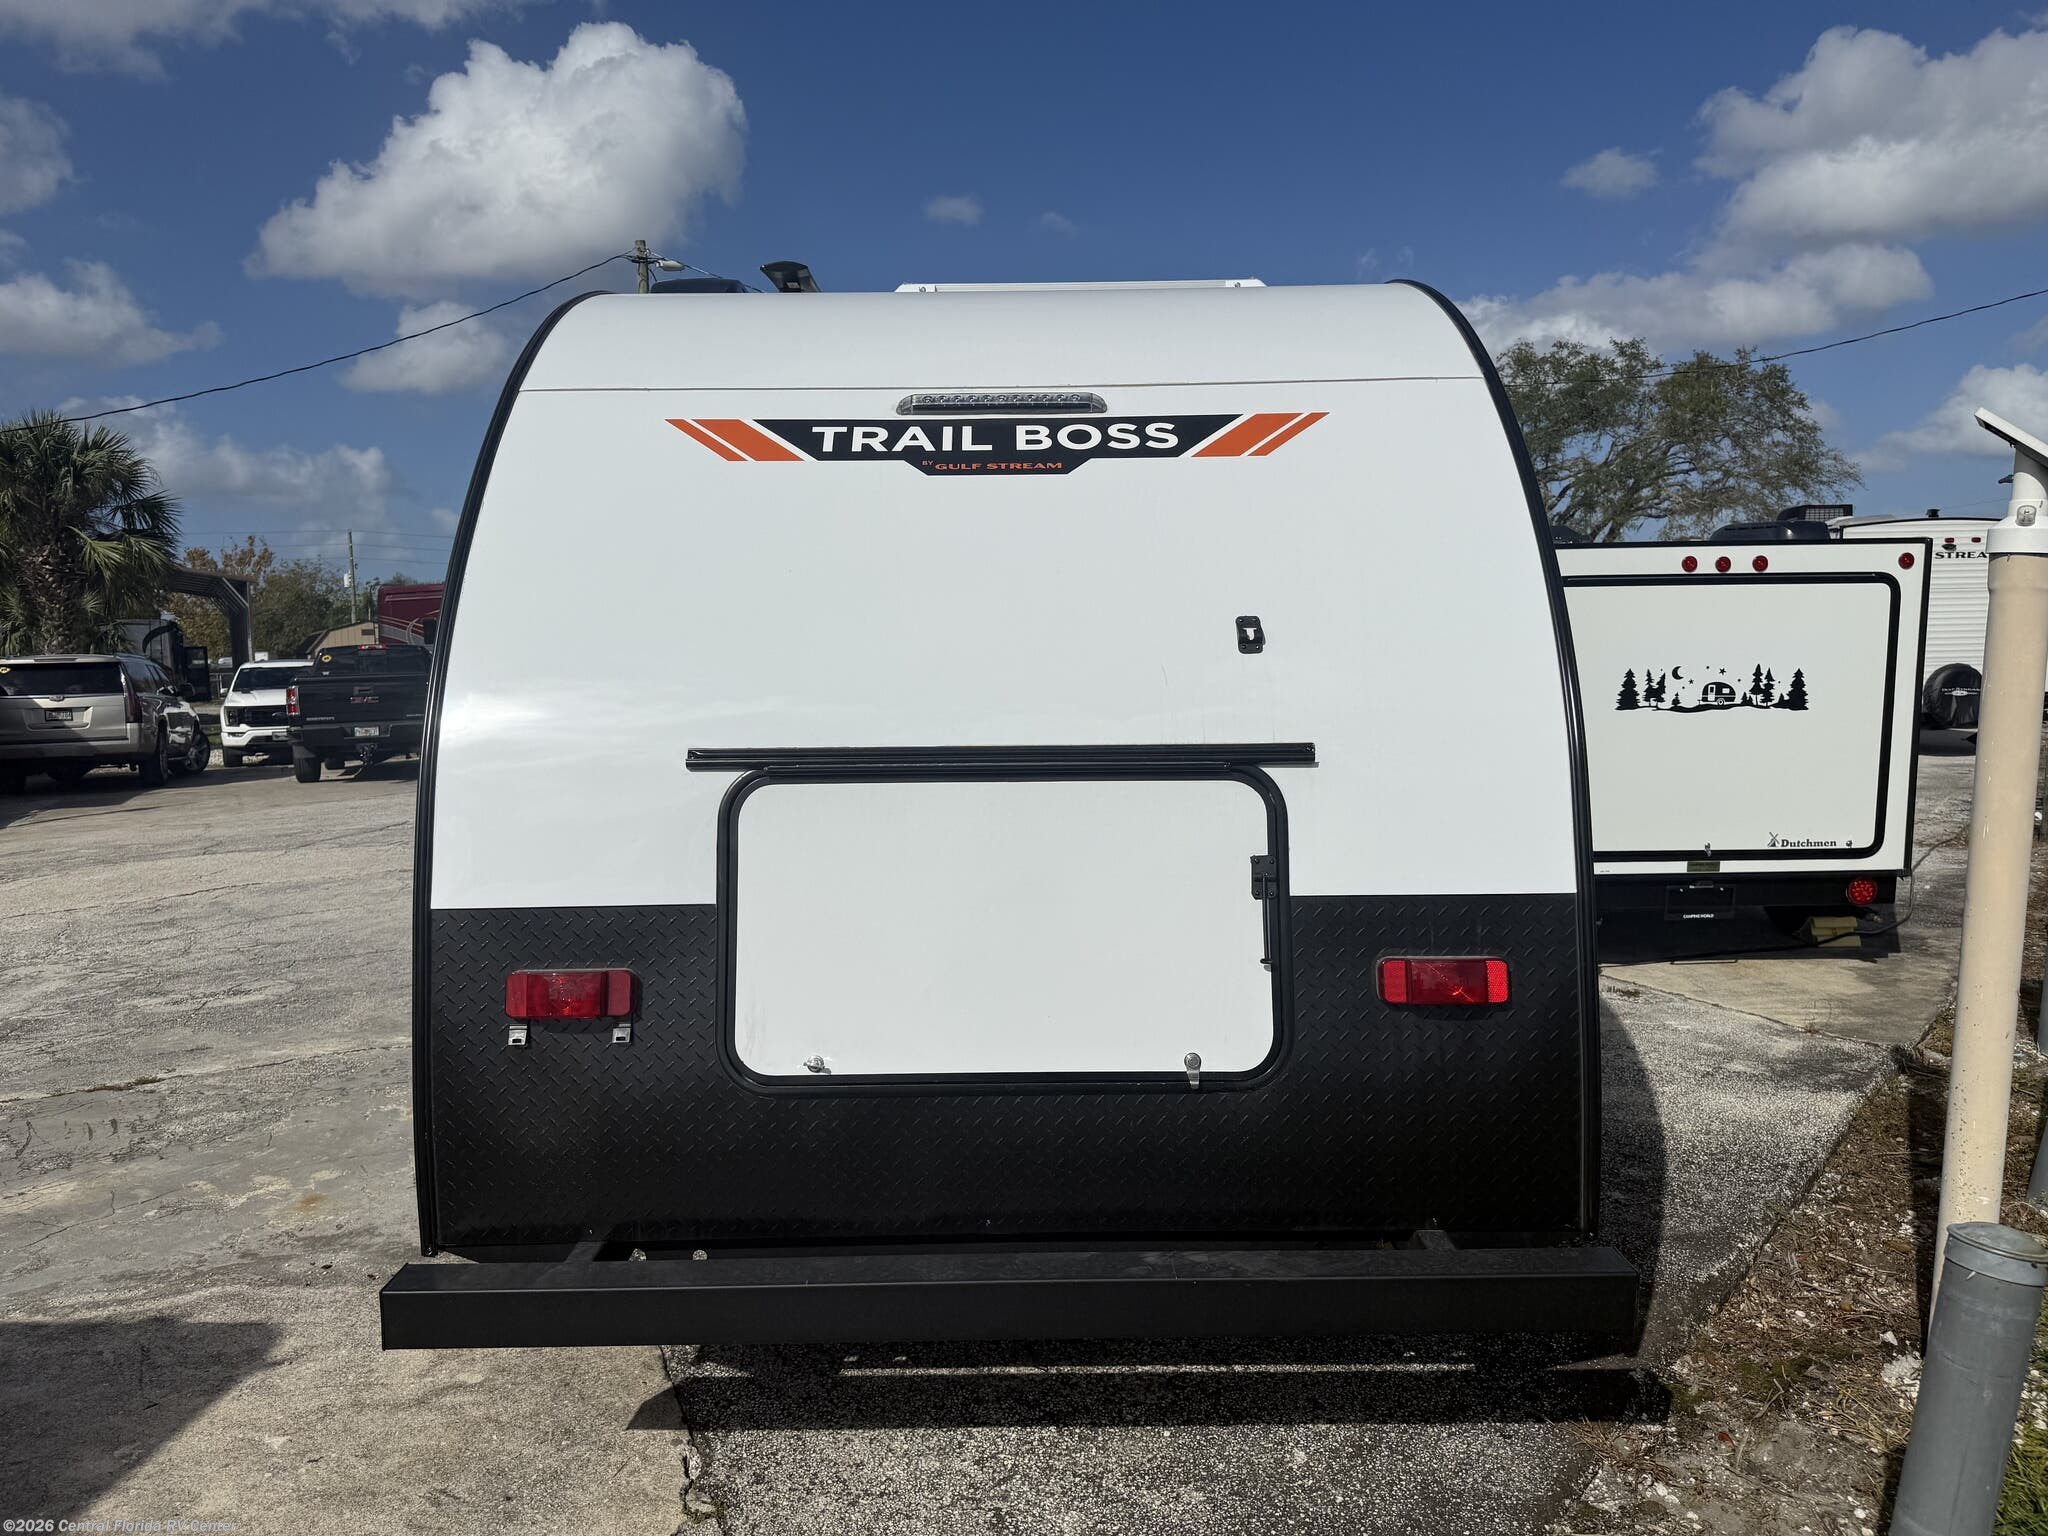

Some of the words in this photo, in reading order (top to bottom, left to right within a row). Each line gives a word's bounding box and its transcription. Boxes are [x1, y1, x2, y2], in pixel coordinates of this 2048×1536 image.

[812, 426, 993, 452] TRAIL
[1016, 423, 1179, 450] BOSS
[986, 462, 1063, 470] STREAM
[1934, 551, 1988, 559] STREA
[1780, 839, 1837, 848] Dutchmen
